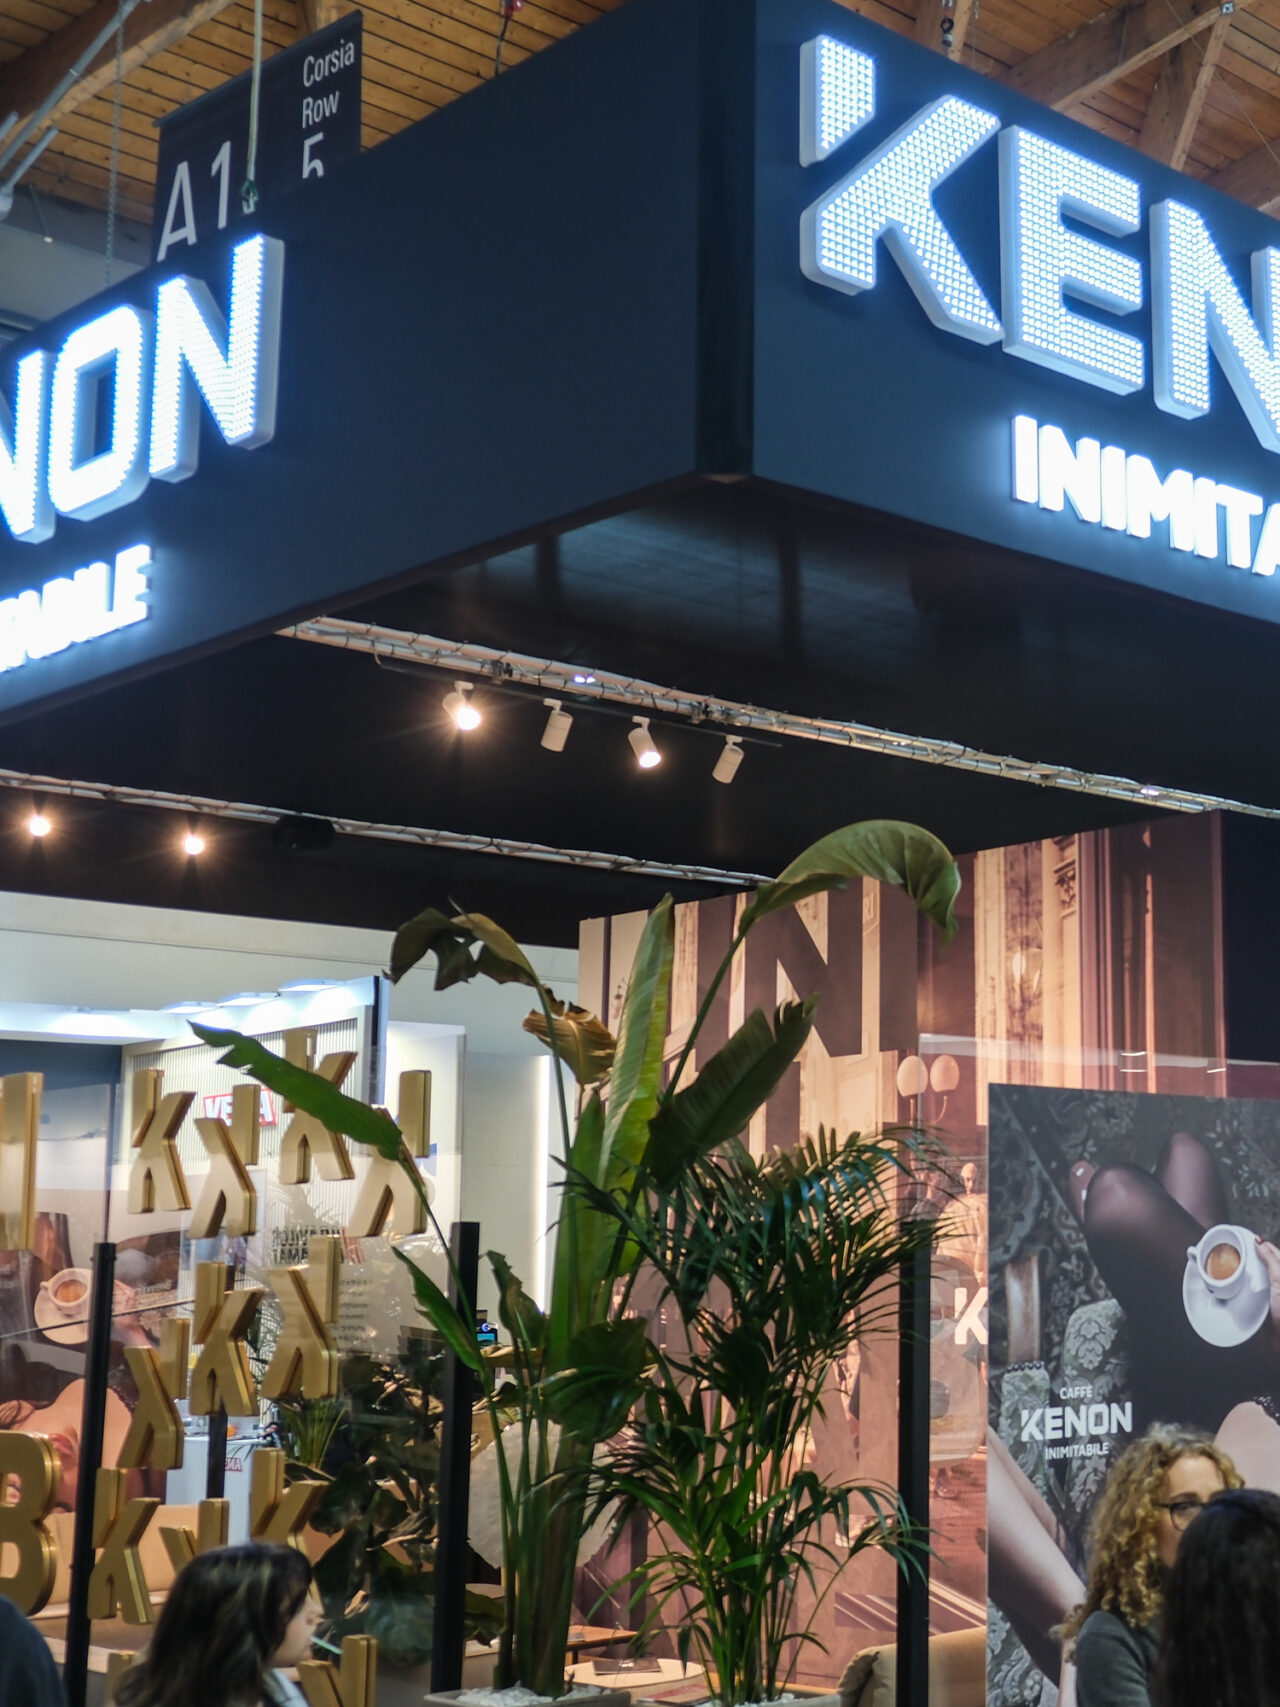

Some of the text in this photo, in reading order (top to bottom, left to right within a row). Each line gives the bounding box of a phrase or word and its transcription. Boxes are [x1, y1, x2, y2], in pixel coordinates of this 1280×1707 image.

[303, 39, 355, 87] Corsia
[302, 91, 339, 129] Row
[203, 1089, 276, 1126] VEA
[1021, 1401, 1133, 1442] KENON
[1045, 1442, 1110, 1461] INIMITABILE
